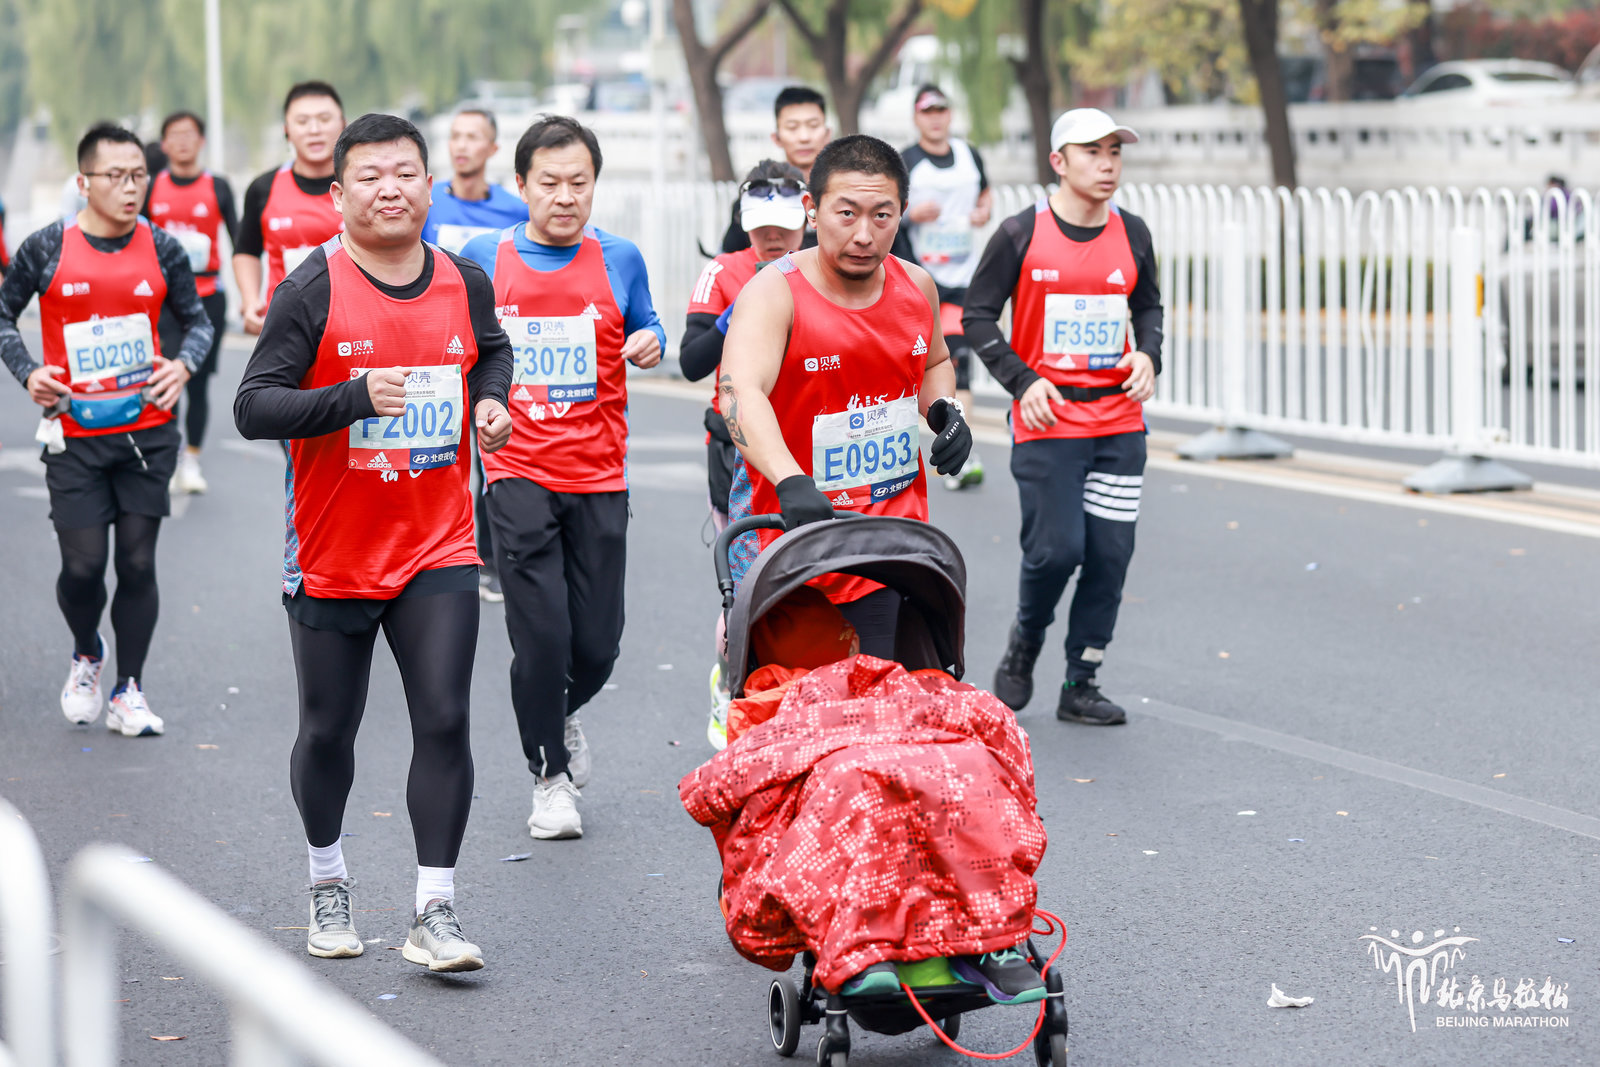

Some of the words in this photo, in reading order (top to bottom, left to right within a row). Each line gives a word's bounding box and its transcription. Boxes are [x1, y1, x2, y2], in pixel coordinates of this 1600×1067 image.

[1054, 321, 1120, 346] F3557
[353, 340, 374, 351] 贝壳
[76, 339, 147, 373] E0208
[820, 355, 840, 367] 贝壳
[408, 371, 431, 384] 贝壳
[867, 407, 888, 422] 贝壳
[824, 432, 912, 482] E0953
